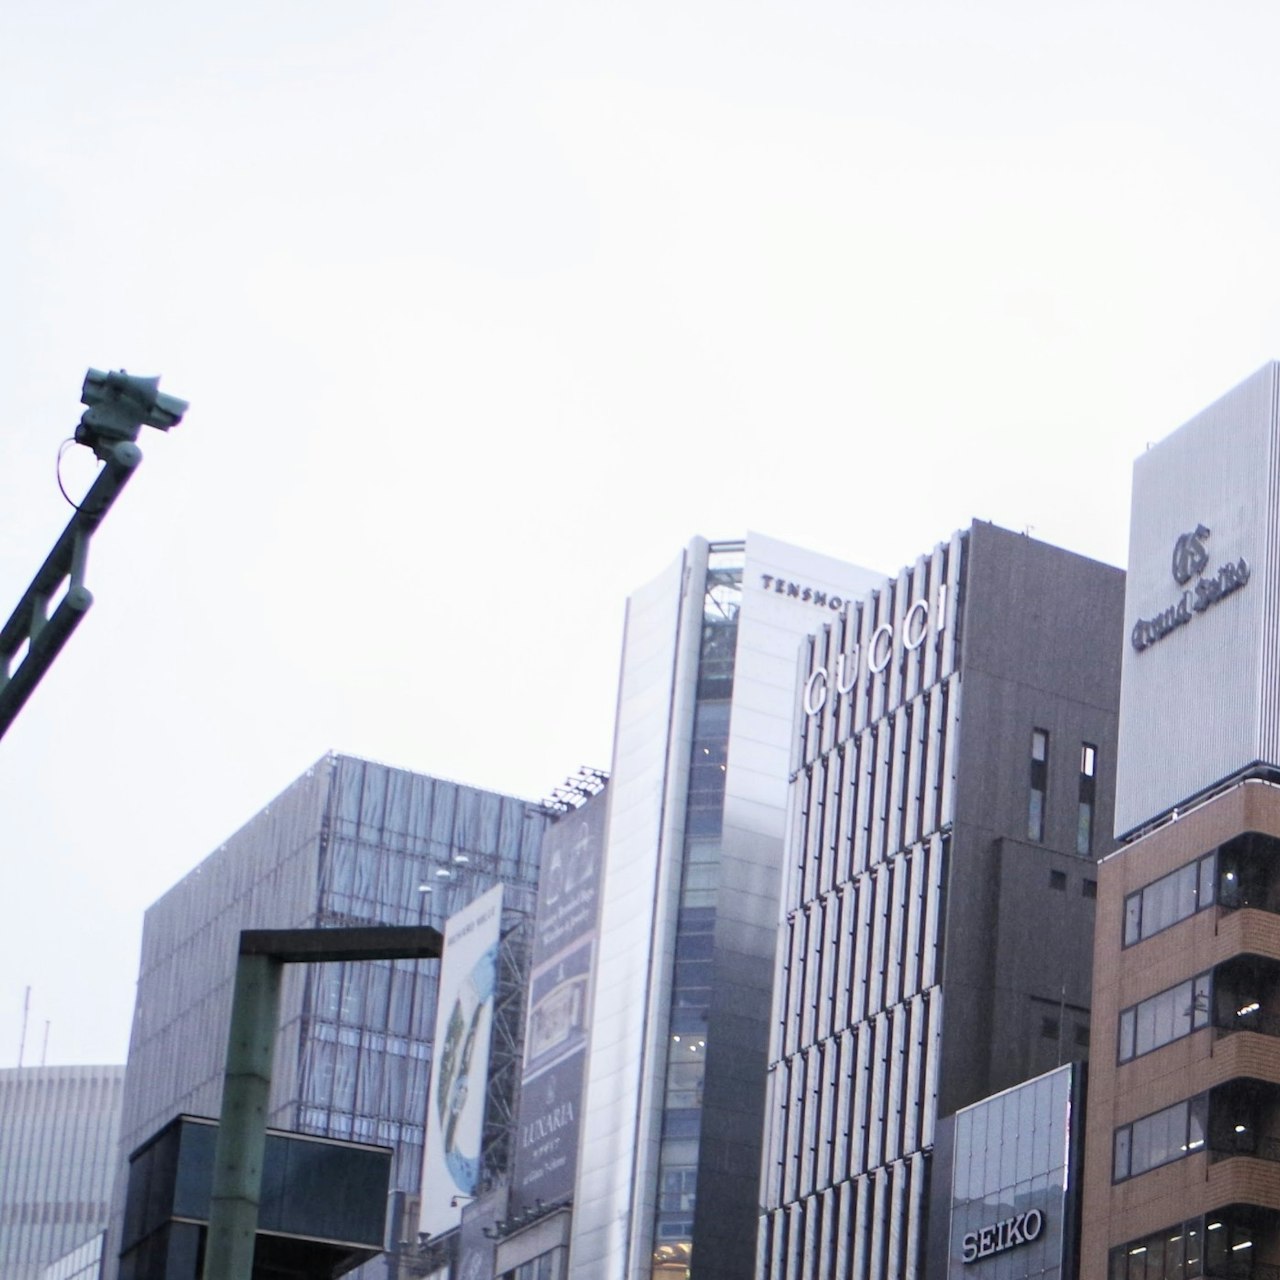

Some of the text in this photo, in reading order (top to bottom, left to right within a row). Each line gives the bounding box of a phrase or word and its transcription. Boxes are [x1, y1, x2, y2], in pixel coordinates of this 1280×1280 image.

[761, 574, 849, 612] TENSHO
[1194, 557, 1250, 612] Seiko
[804, 584, 946, 715] GUCCI
[962, 1208, 1042, 1263] SEIKO
